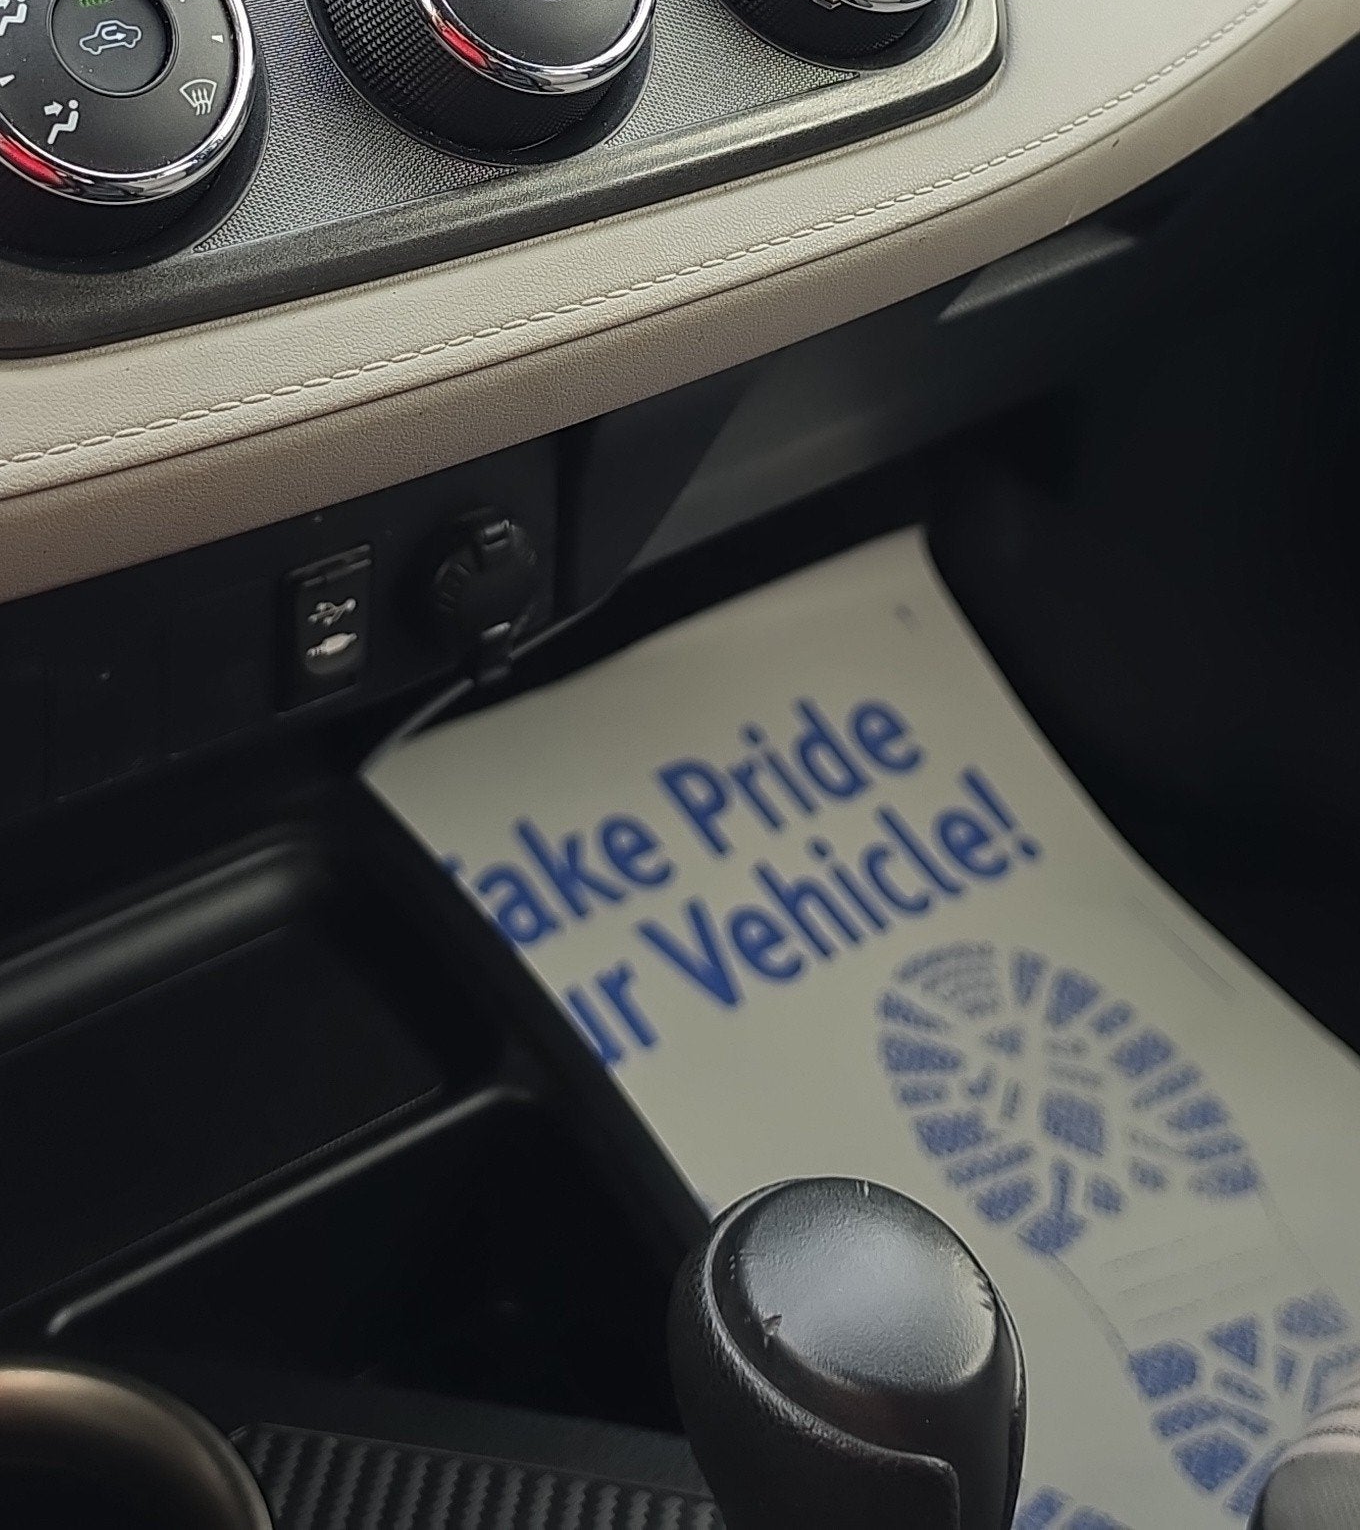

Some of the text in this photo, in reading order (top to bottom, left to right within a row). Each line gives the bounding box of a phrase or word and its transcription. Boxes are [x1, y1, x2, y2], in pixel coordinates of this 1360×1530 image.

[442, 695, 928, 947] ake Pride
[635, 765, 1045, 1008] Vehicle!
